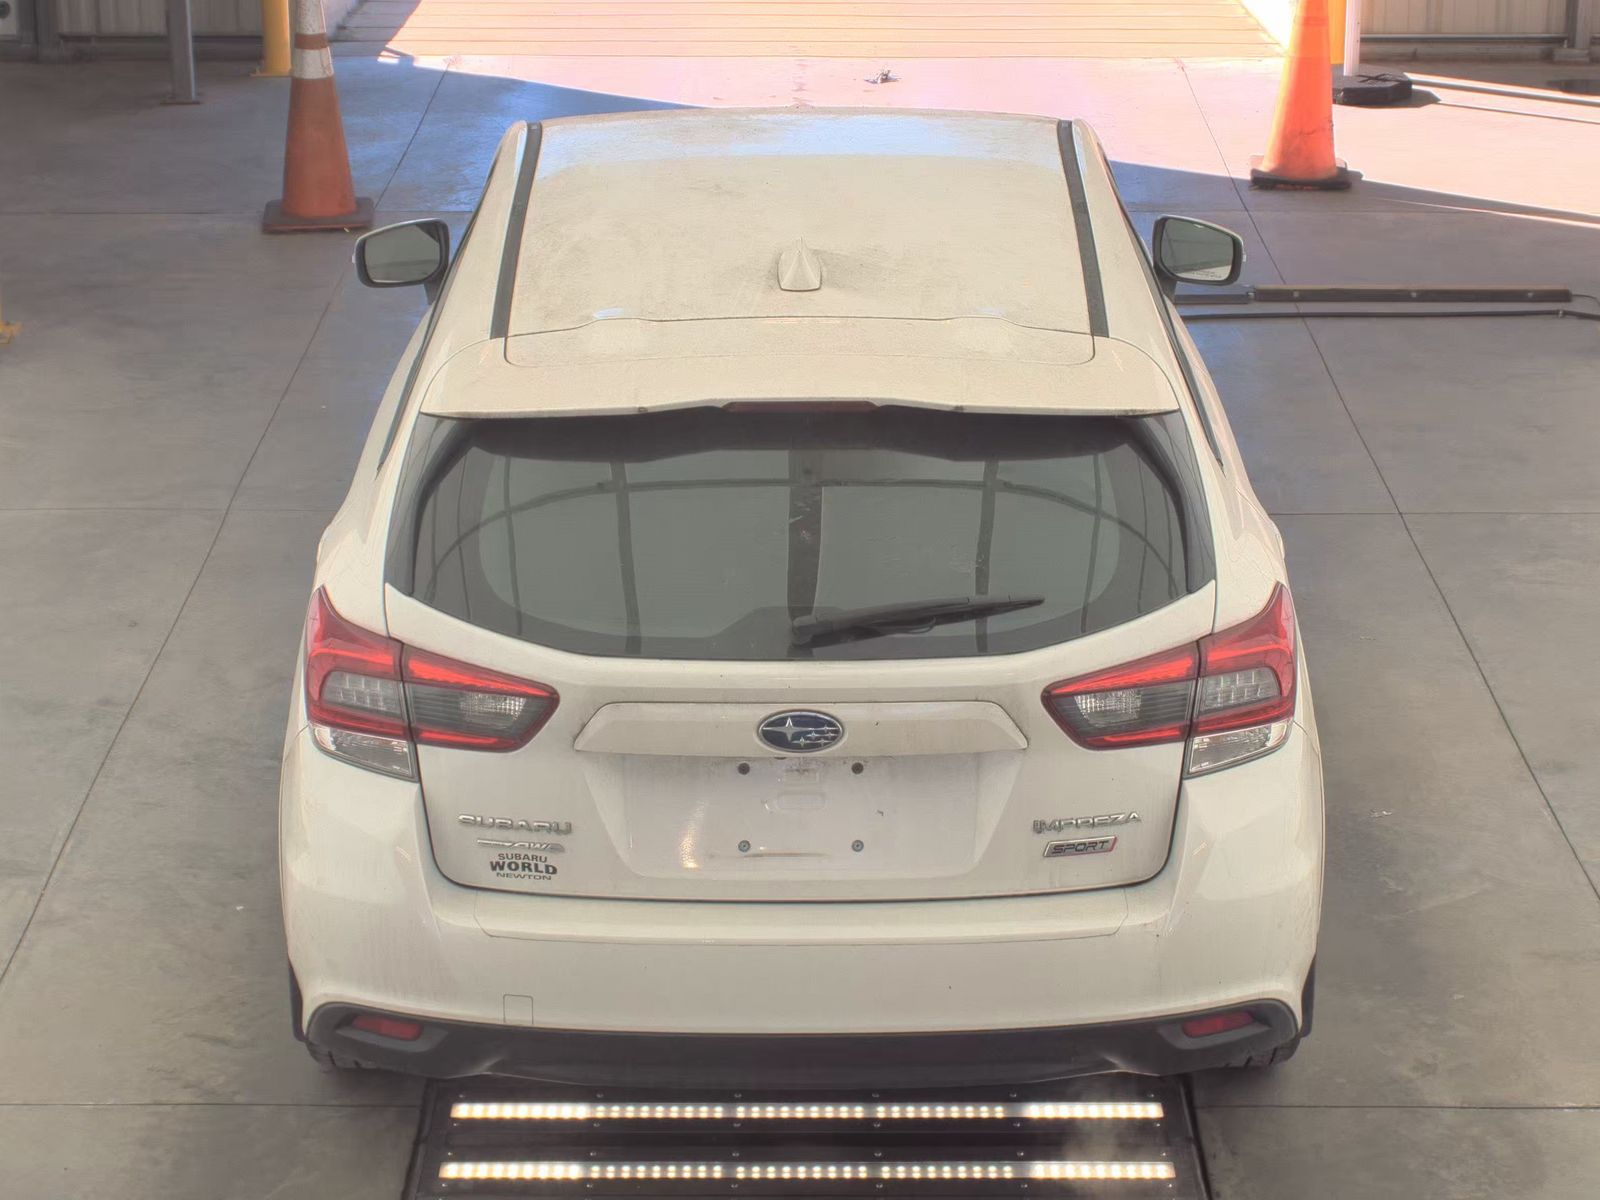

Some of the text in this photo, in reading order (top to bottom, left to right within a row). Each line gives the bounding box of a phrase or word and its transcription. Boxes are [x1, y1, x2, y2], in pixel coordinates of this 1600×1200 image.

[458, 814, 573, 835] SUBARU
[1033, 811, 1142, 833] IMPREZA
[1052, 840, 1110, 854] SPORT
[498, 853, 548, 863] SUBARU
[490, 861, 558, 875] WORLD
[496, 872, 552, 880] NEWTON
